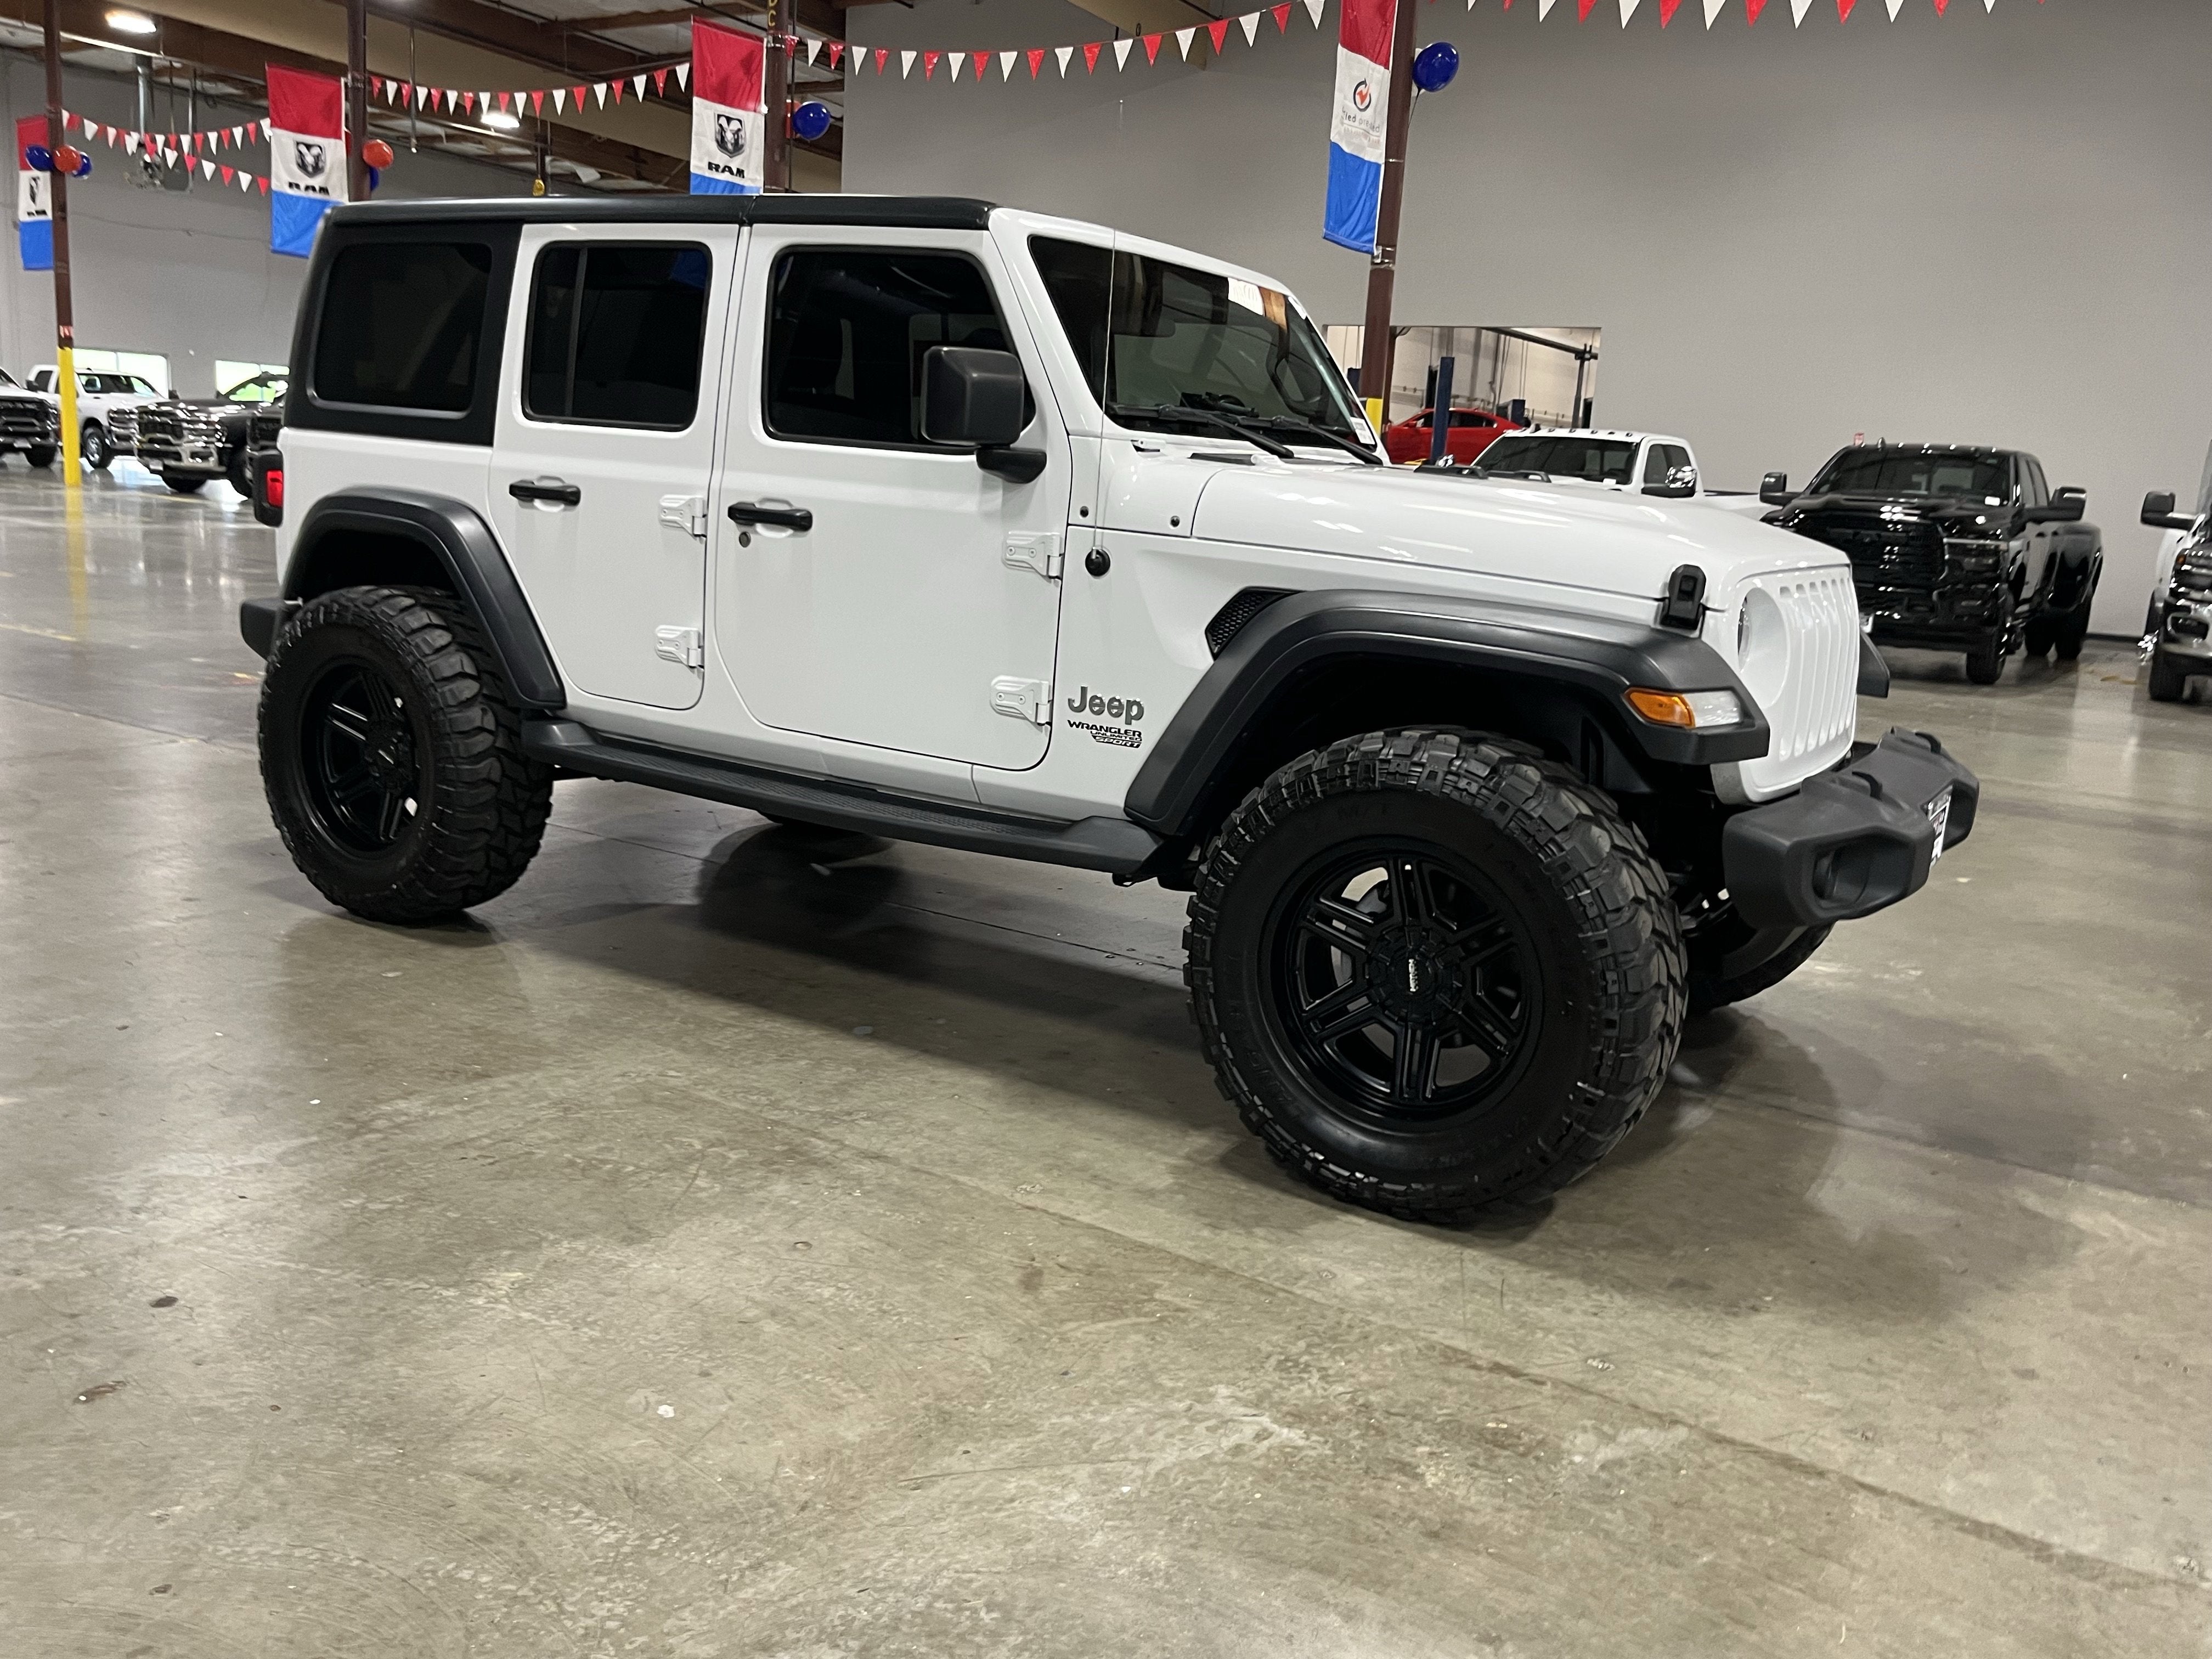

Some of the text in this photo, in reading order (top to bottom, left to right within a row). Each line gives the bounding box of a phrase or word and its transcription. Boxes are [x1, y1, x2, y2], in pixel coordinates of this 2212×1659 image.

[708, 161, 745, 179] RAM
[1068, 686, 1144, 725] Jeep
[1067, 719, 1142, 738] WRANGLER
[1090, 730, 1142, 742] UNLIMITED
[1094, 736, 1142, 748] SPORT
